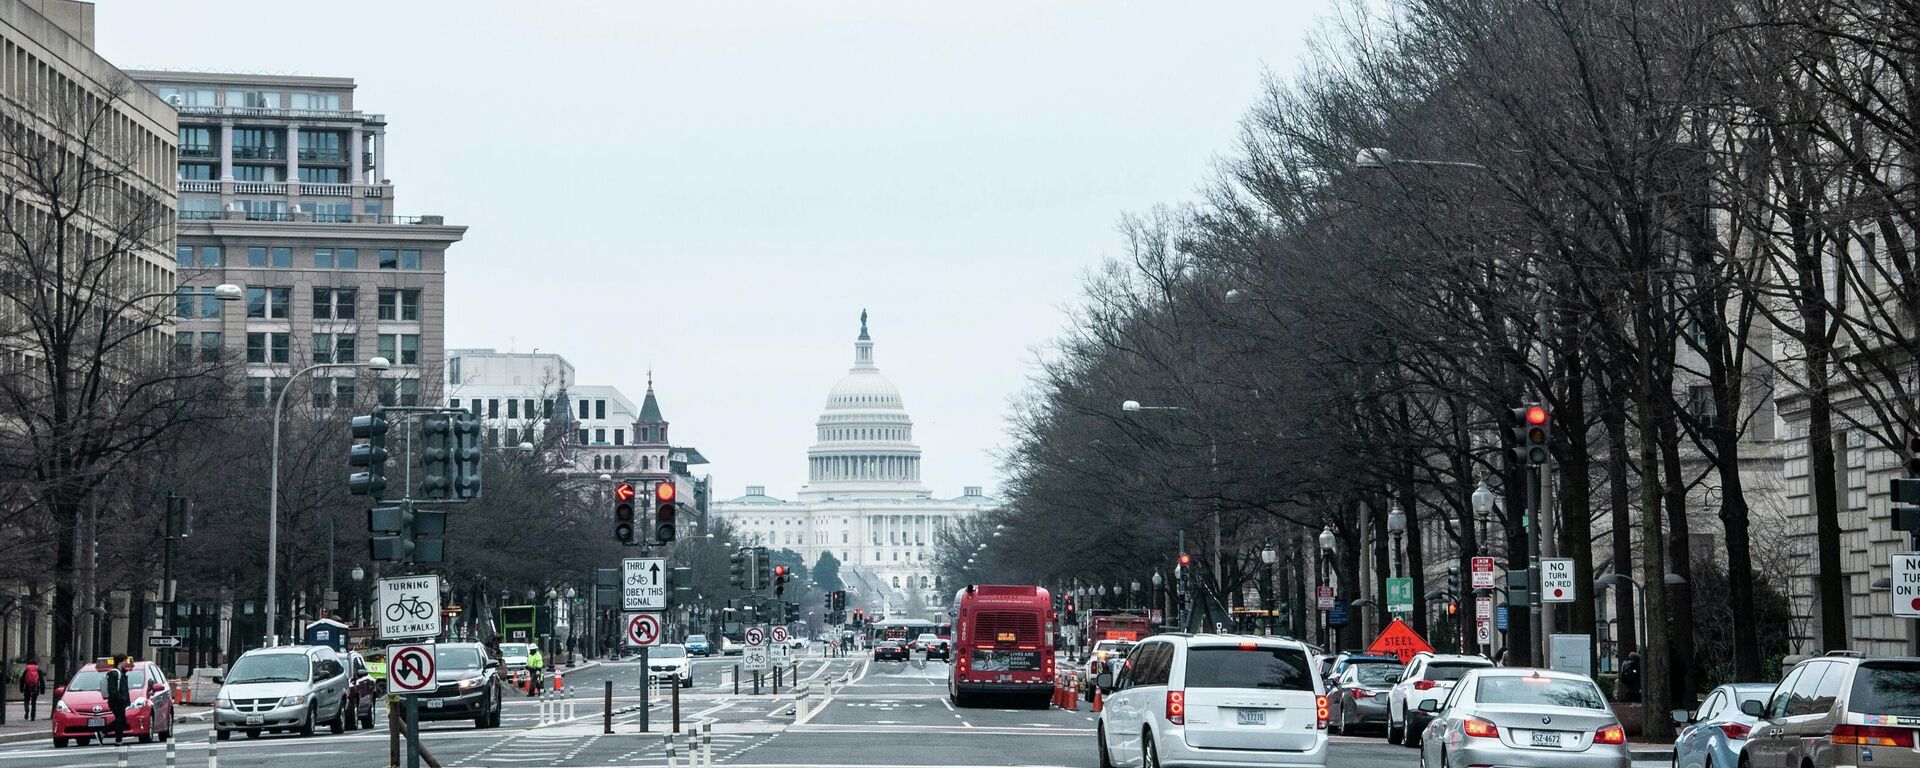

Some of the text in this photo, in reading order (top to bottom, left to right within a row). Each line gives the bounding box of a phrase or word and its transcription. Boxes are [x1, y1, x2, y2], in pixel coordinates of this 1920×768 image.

[626, 562, 645, 571] THRU
[1550, 562, 1565, 571] NO
[1906, 558, 1920, 570] N
[1548, 572, 1568, 580] TURN
[388, 581, 429, 591] TURNING
[1544, 580, 1572, 588] ON RED
[625, 587, 664, 597] OBEY THIS
[1896, 585, 1912, 596] ON
[625, 597, 652, 606] SIGNAL
[386, 622, 435, 634] USE X-WALKS
[1384, 636, 1414, 647] STEEL
